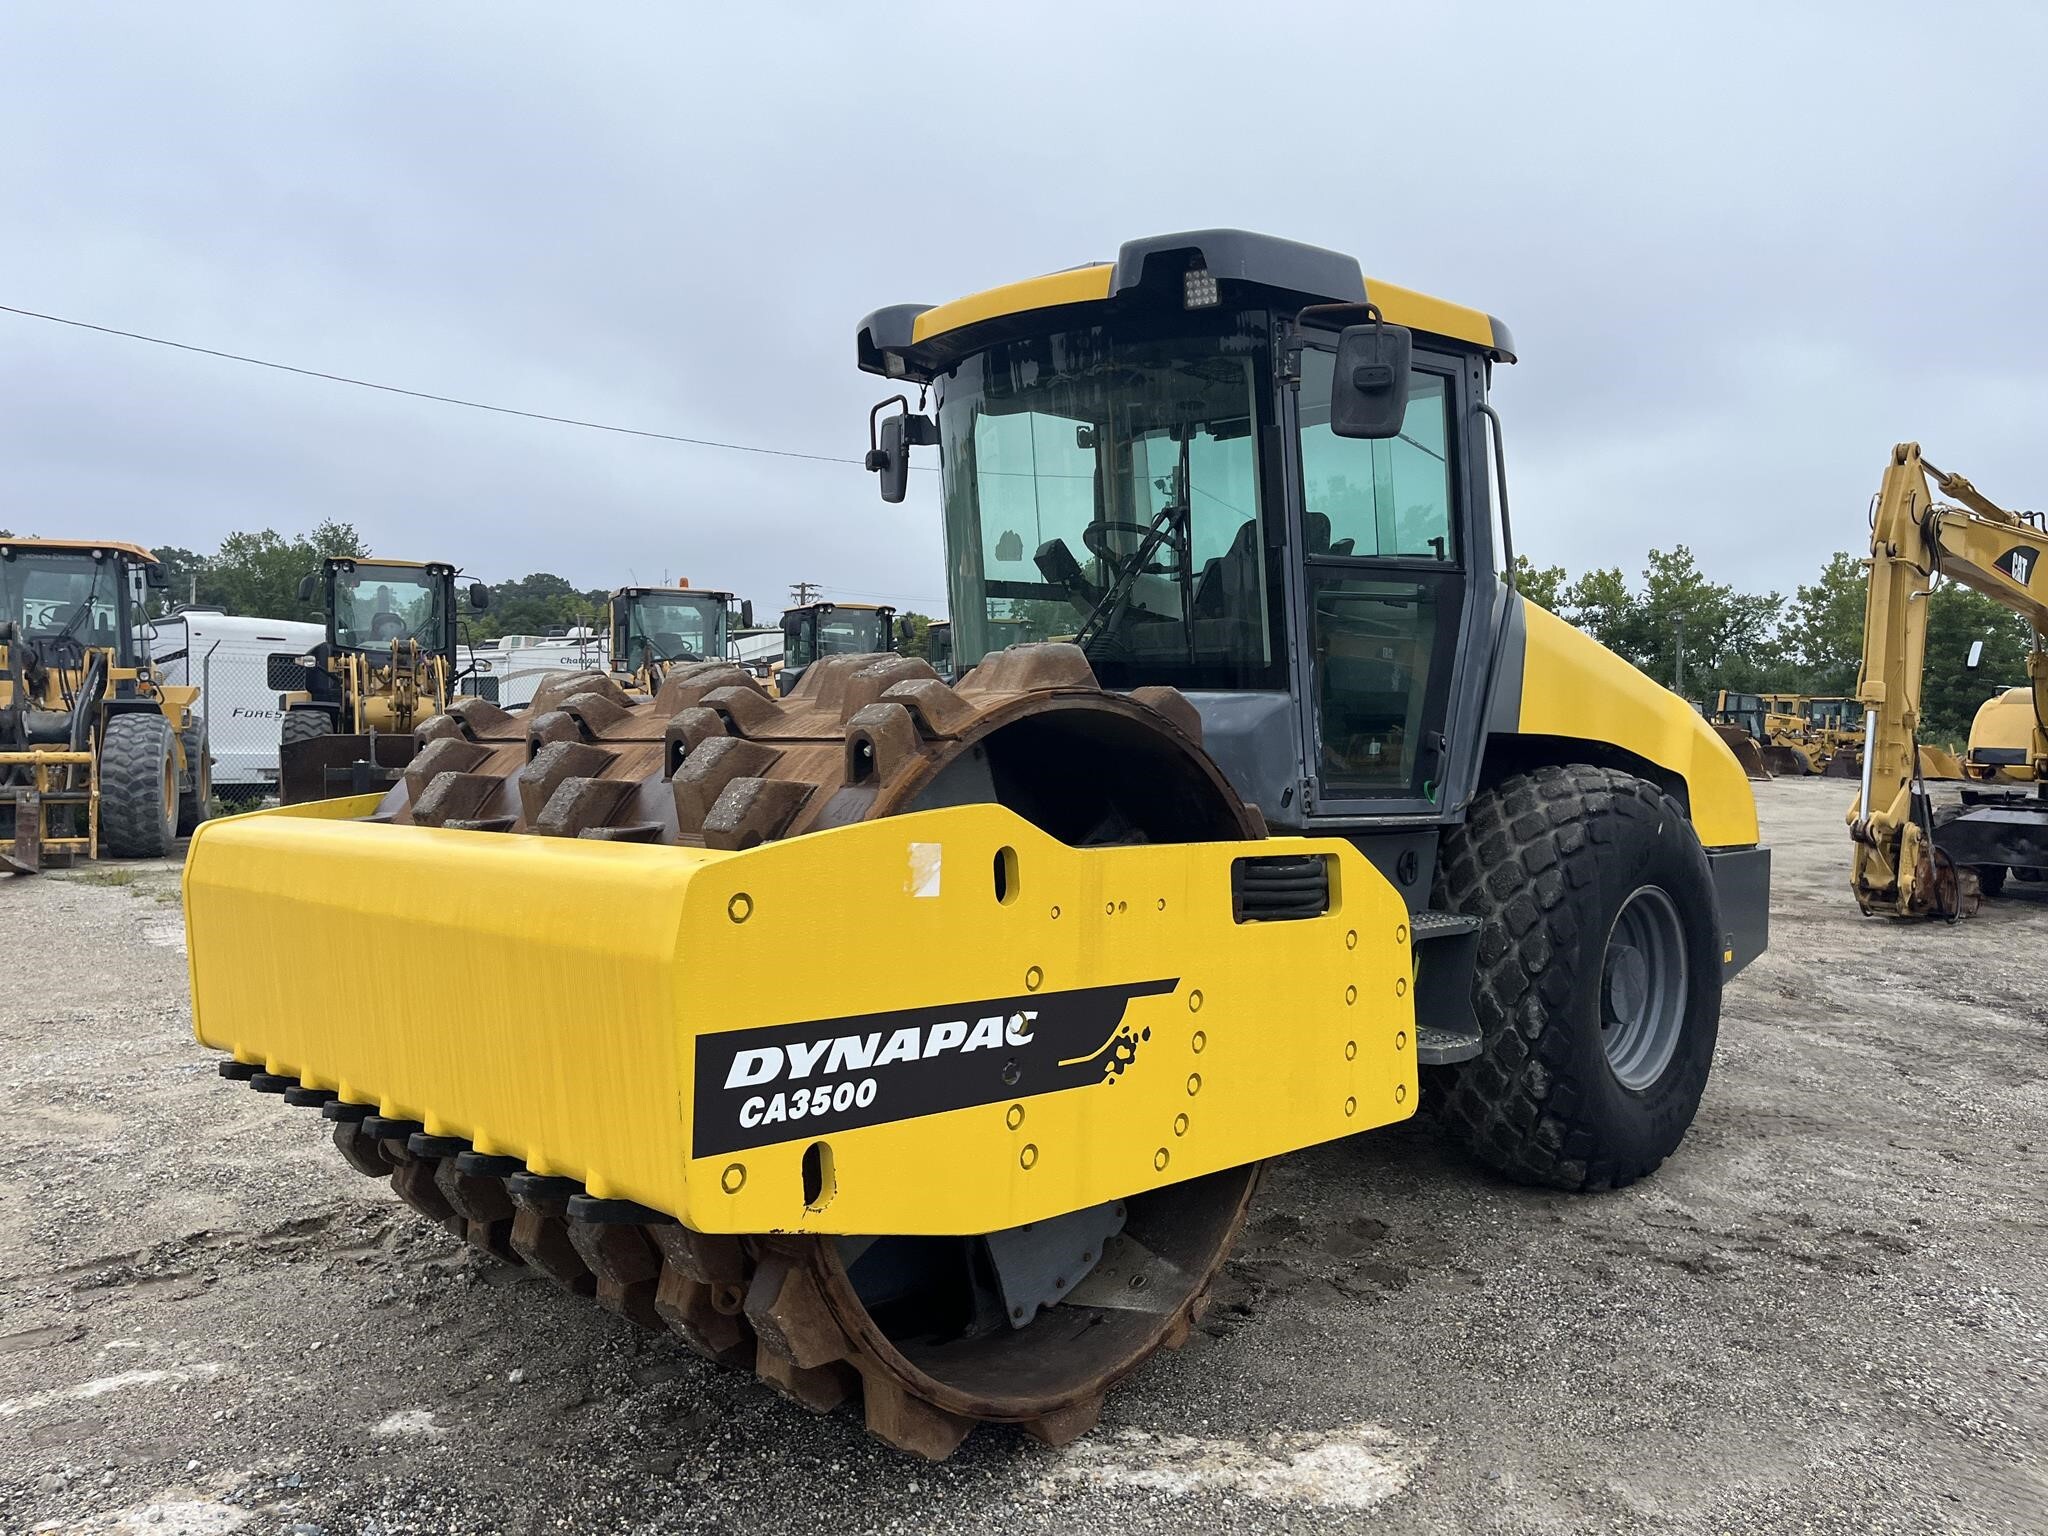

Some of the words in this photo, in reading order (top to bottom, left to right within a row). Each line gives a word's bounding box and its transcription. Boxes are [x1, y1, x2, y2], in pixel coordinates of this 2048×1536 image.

[2011, 552, 2028, 584] CAT
[723, 1011, 1038, 1090] DYNAPAC
[739, 1078, 877, 1128] CA3500
